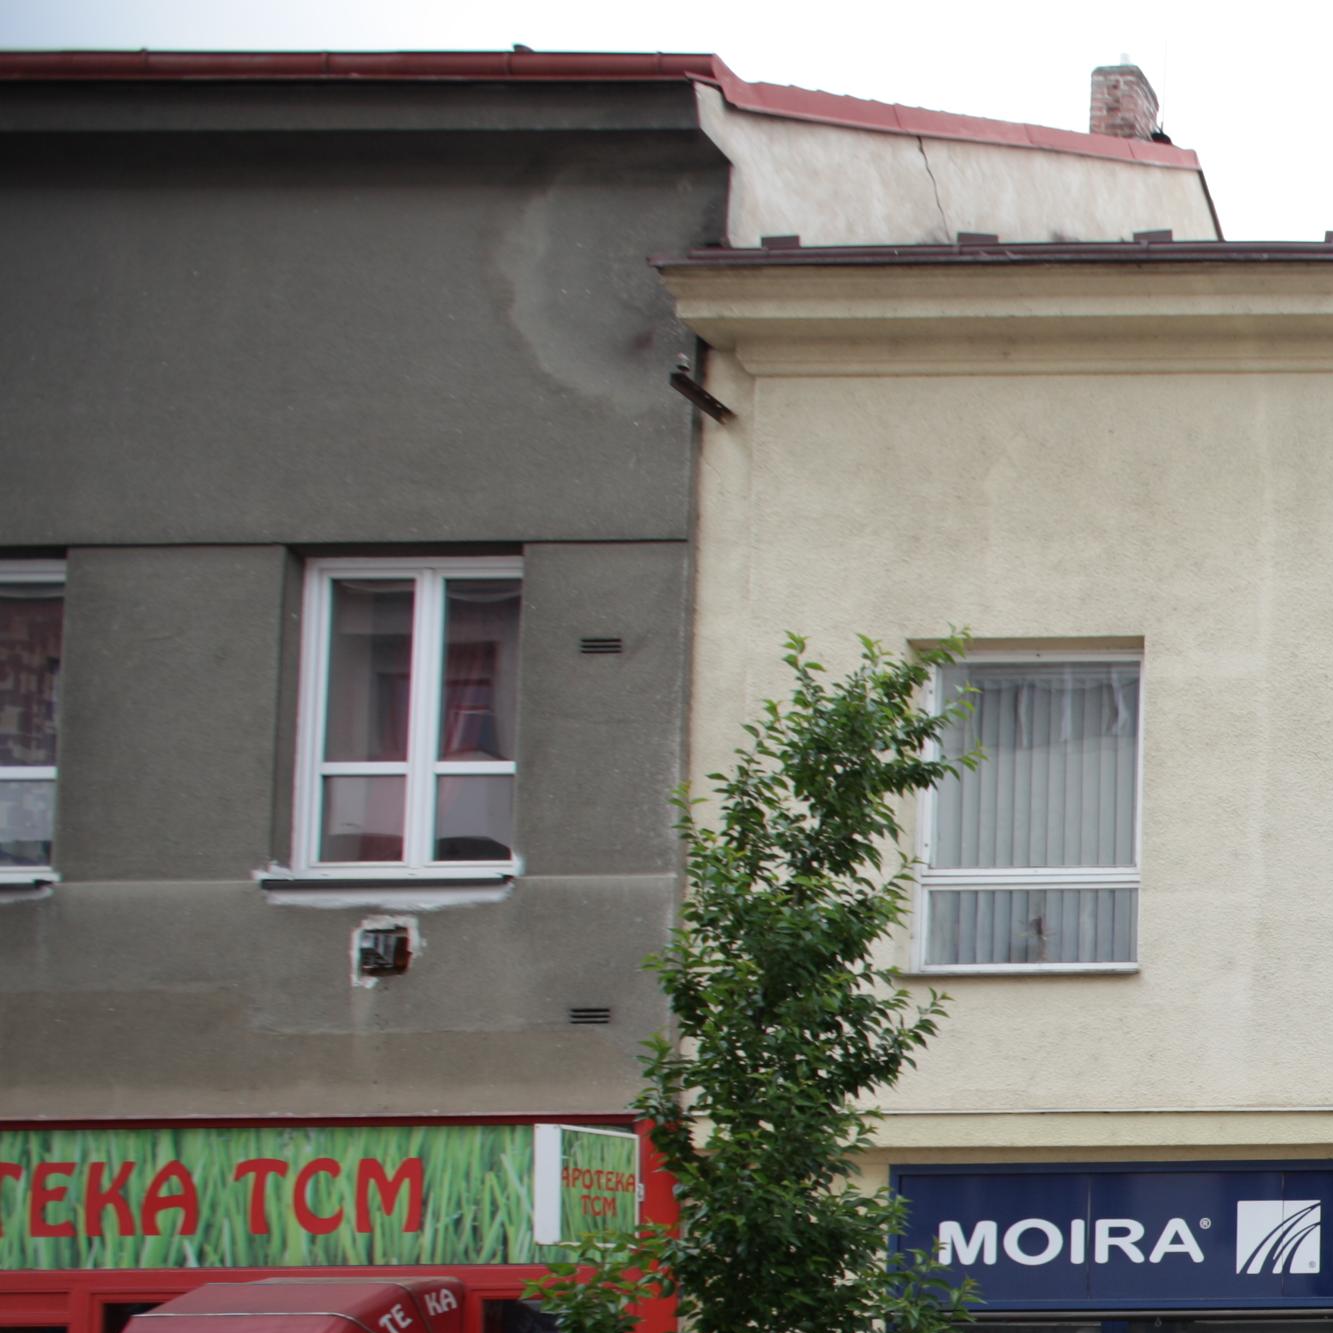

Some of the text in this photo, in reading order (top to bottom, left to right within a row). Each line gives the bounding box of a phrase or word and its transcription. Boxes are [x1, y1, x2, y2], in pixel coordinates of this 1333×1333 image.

[561, 1167, 636, 1193] APOTEKA
[234, 1157, 424, 1235] TCM
[580, 1194, 618, 1217] TCM
